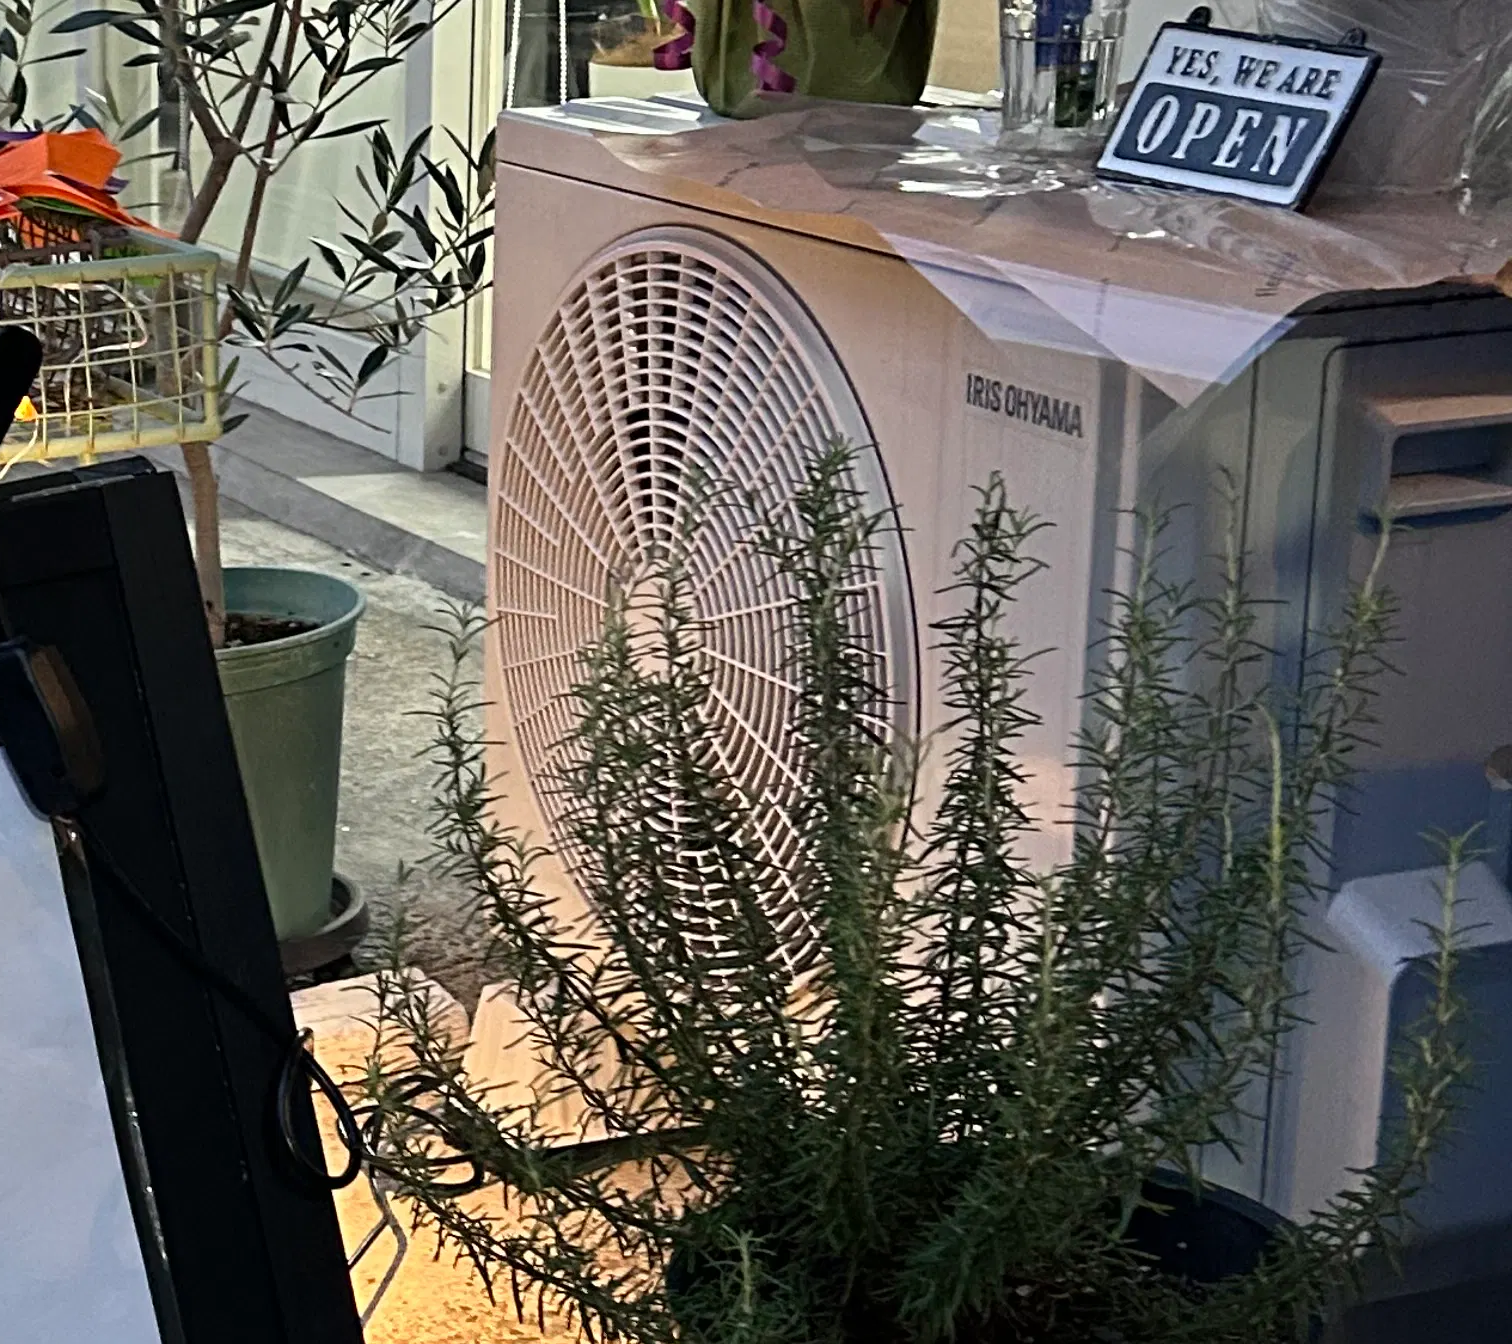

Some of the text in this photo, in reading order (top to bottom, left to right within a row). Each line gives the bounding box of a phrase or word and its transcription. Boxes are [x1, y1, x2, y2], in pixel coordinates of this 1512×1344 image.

[1165, 45, 1342, 99] YES, WE ARE
[1136, 93, 1310, 176] OPEN
[966, 372, 1084, 438] IRIS OHYAMA
